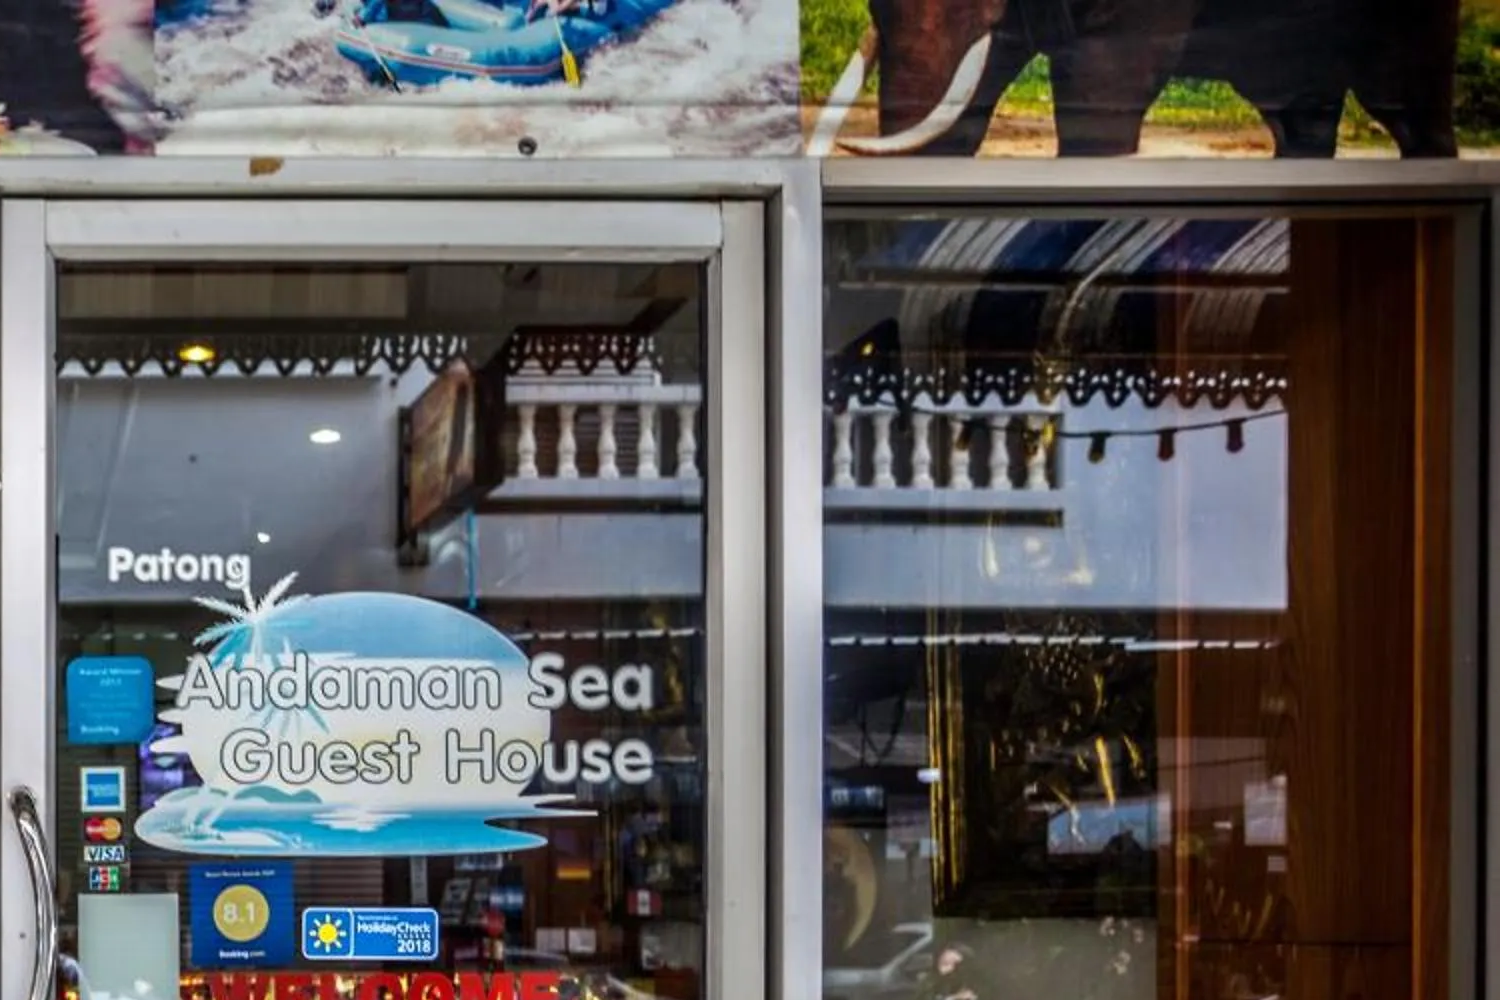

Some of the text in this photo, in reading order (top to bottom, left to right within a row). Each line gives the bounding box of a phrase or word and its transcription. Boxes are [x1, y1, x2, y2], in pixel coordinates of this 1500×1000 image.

[107, 547, 251, 589] Patong
[176, 650, 652, 710] Andaman Sea
[219, 728, 654, 784] Guest House
[87, 847, 123, 860] VISA
[223, 902, 256, 925] 8.1
[397, 939, 431, 953] 2018
